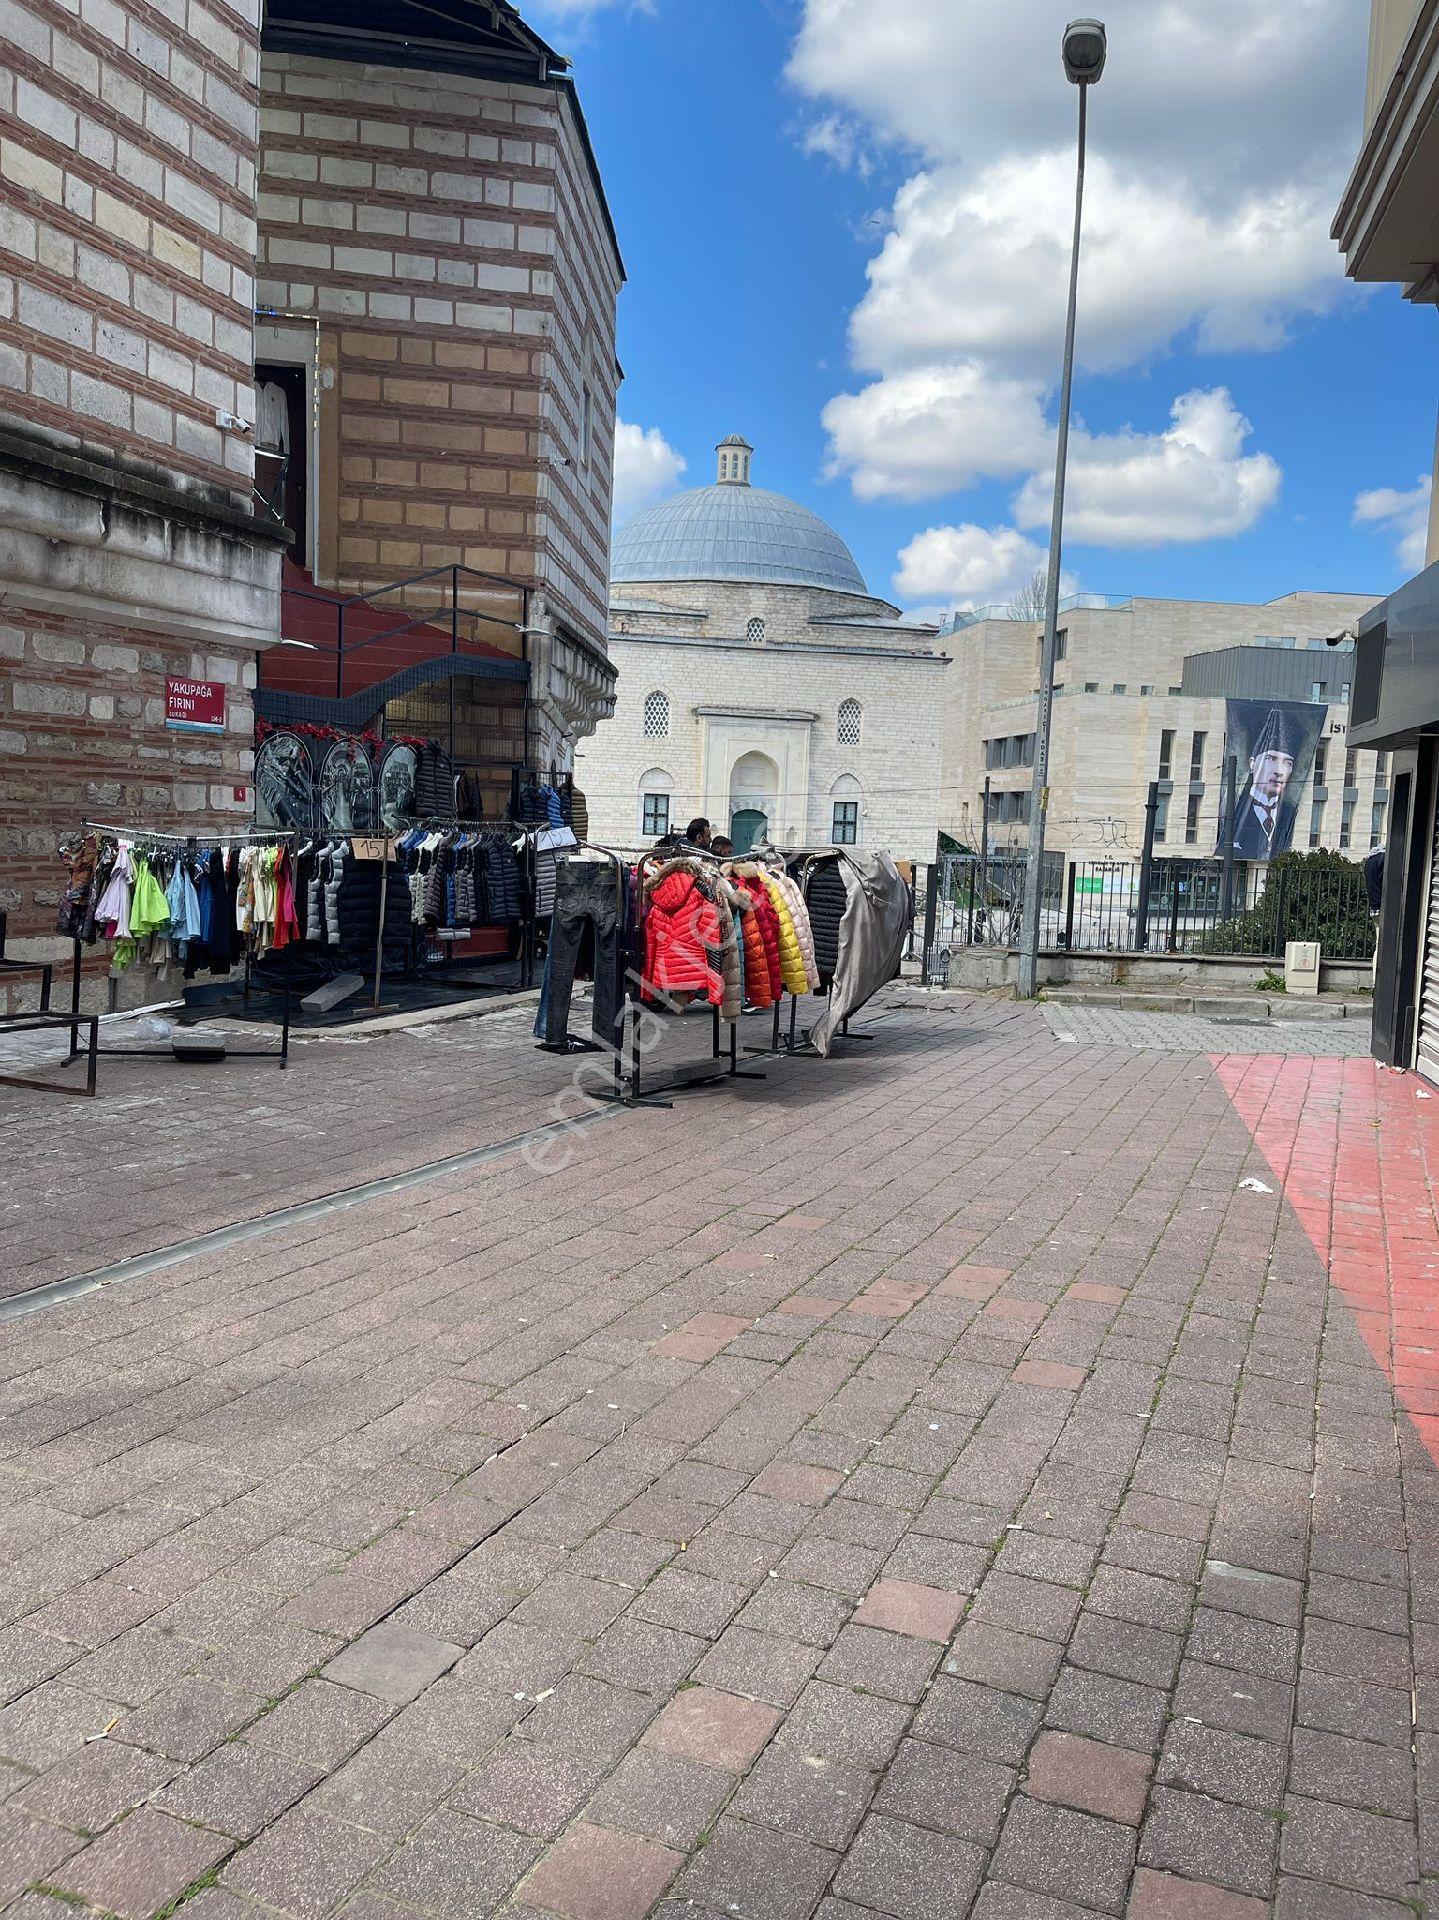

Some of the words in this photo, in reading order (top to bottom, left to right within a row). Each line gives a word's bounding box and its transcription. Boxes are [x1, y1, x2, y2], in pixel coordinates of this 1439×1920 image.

[168, 681, 212, 697] YAKUPAĞA
[169, 697, 194, 710] FIRINI
[361, 840, 383, 857] 15
